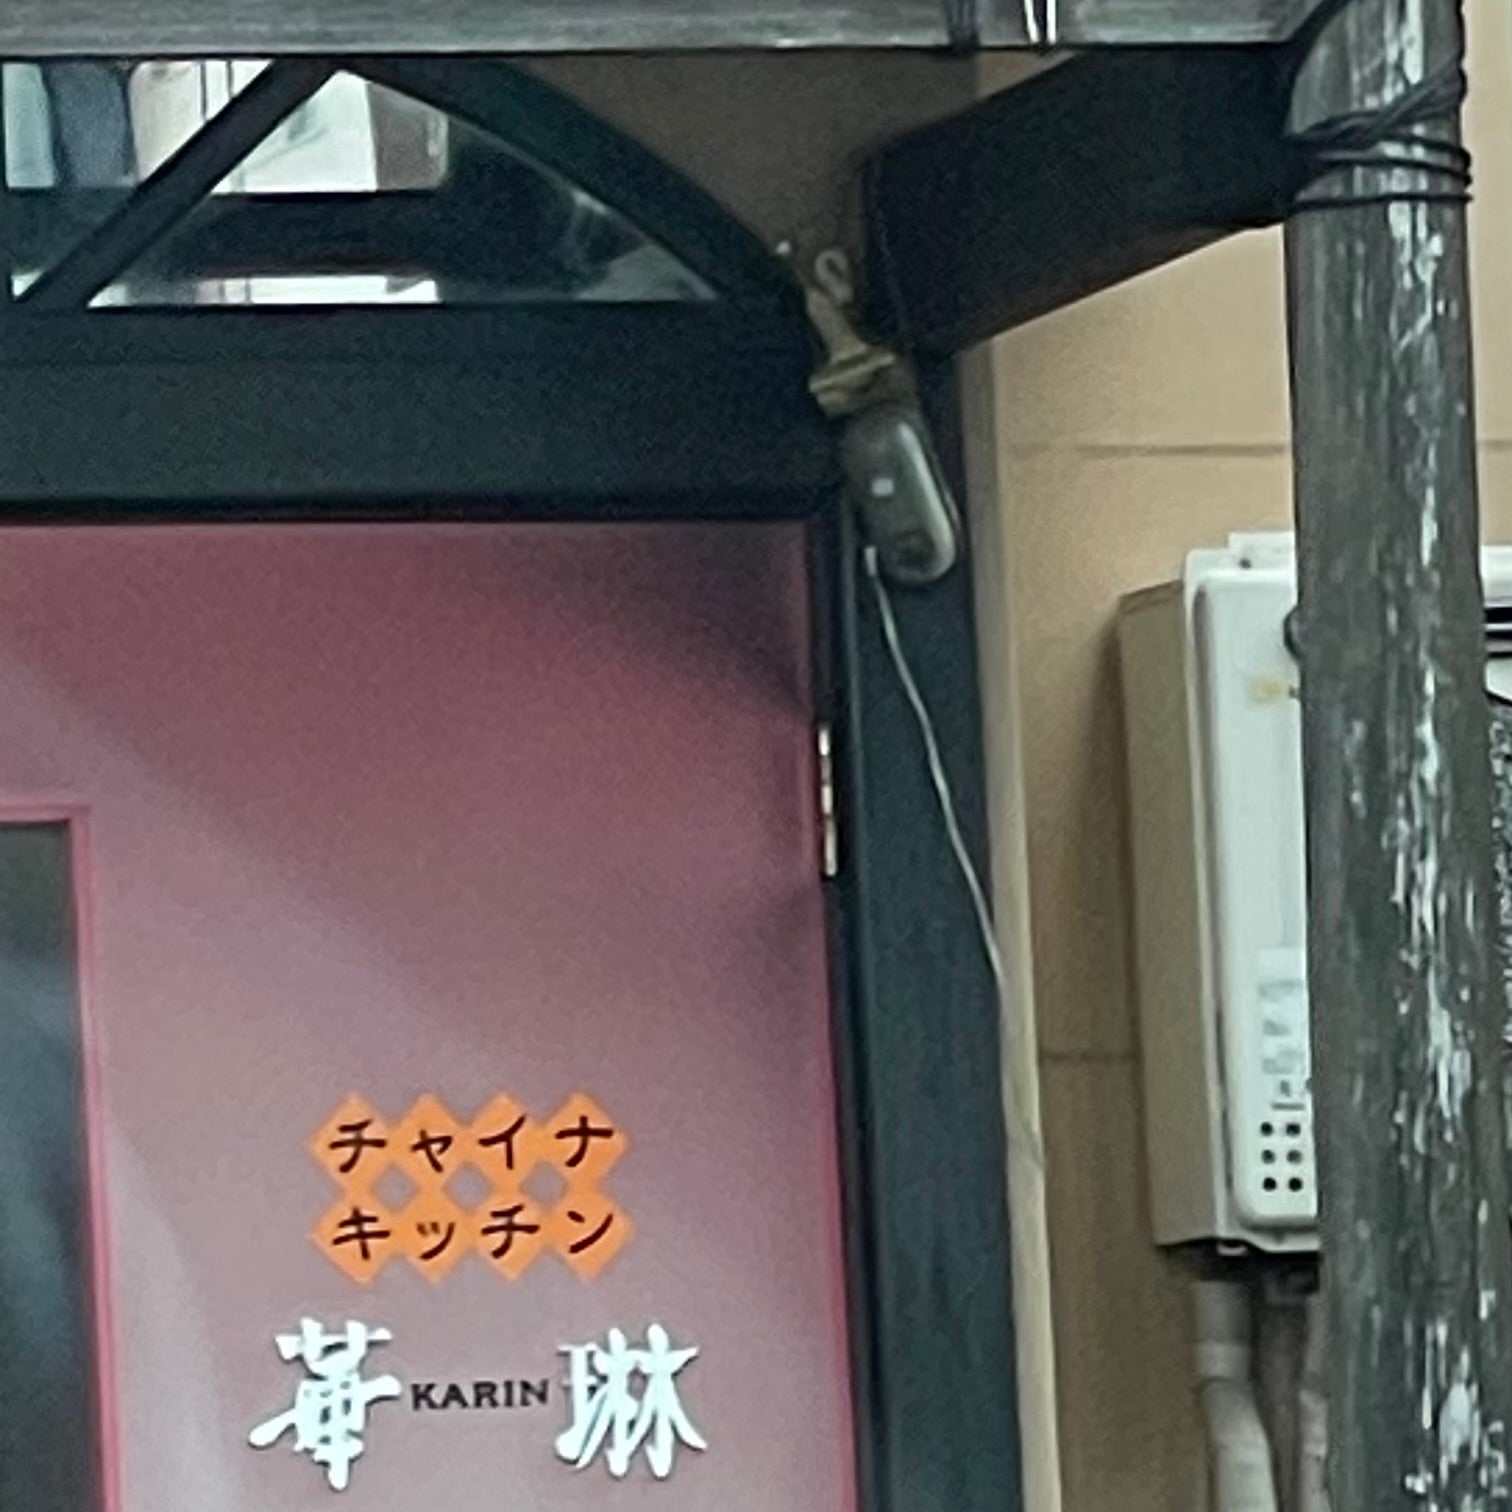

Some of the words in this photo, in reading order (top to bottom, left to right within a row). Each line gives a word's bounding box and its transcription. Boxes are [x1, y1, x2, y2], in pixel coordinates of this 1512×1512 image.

[329, 1115, 613, 1173] チャイナ
[332, 1204, 613, 1260] キッチン
[411, 1379, 549, 1411] KARIN
